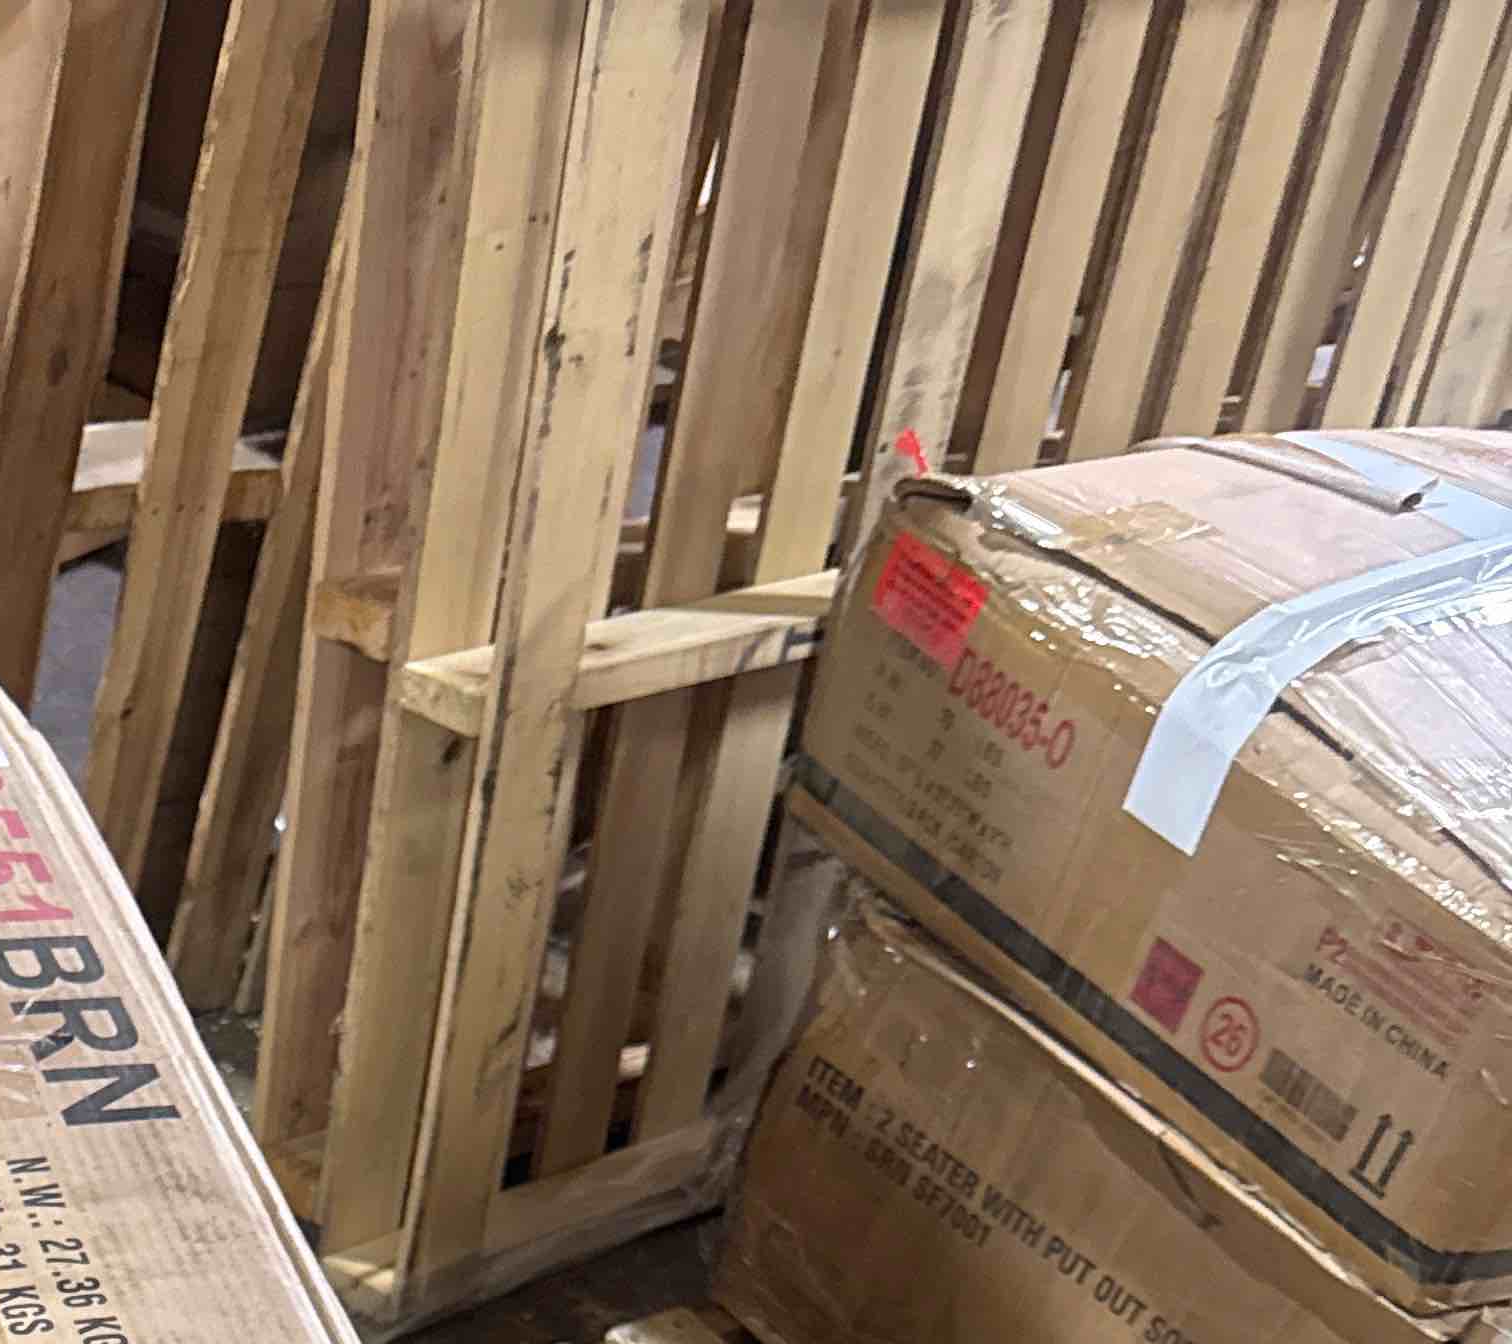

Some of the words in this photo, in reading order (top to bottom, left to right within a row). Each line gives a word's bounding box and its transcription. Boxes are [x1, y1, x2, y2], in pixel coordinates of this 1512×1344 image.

[1386, 1024, 1449, 1080] CHINA
[6, 1155, 65, 1229] N.W.:
[39, 1236, 106, 1311] 27.36
[895, 1121, 980, 1199] SEATER
[982, 1183, 1047, 1249] WITH
[1042, 1234, 1097, 1286] PUT
[1093, 1274, 1149, 1326] OUT
